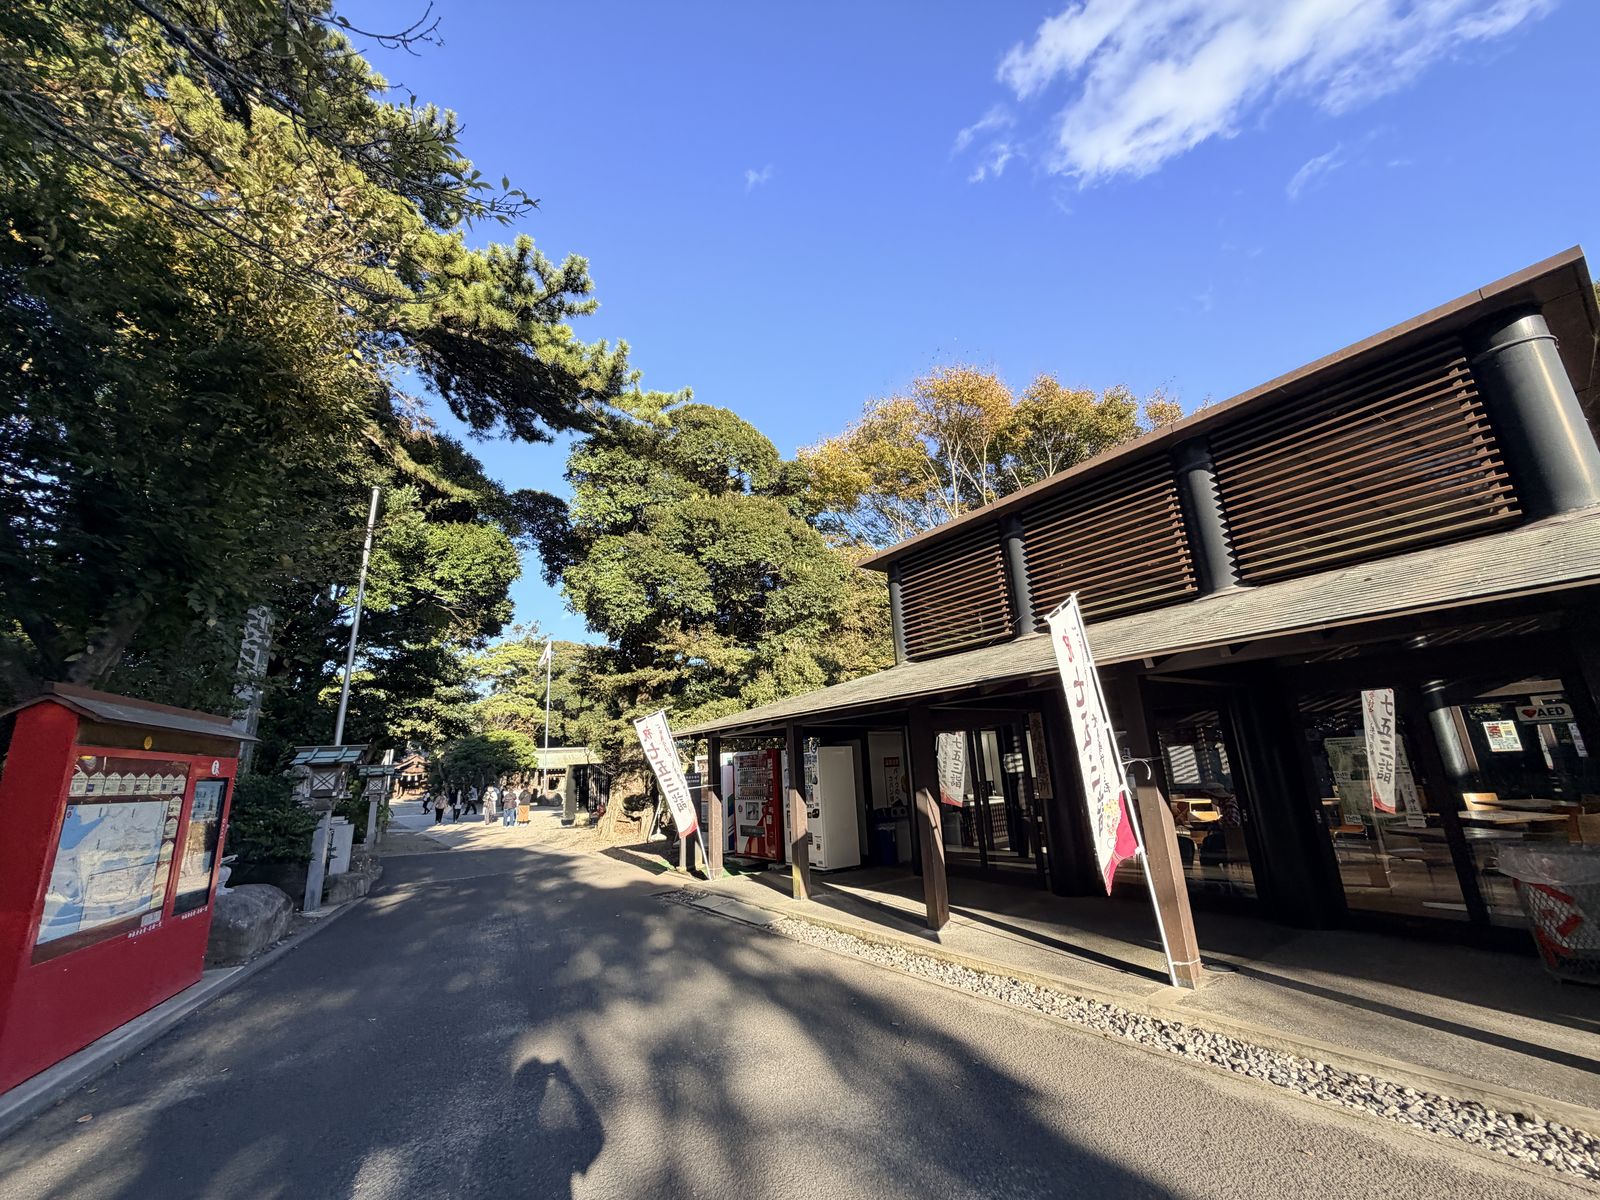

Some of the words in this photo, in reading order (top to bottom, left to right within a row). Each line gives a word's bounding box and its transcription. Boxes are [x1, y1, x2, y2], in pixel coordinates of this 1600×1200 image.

[1537, 706, 1566, 717] AED
[950, 736, 963, 790] 七五三詣
[1376, 694, 1395, 785] 七五三詣
